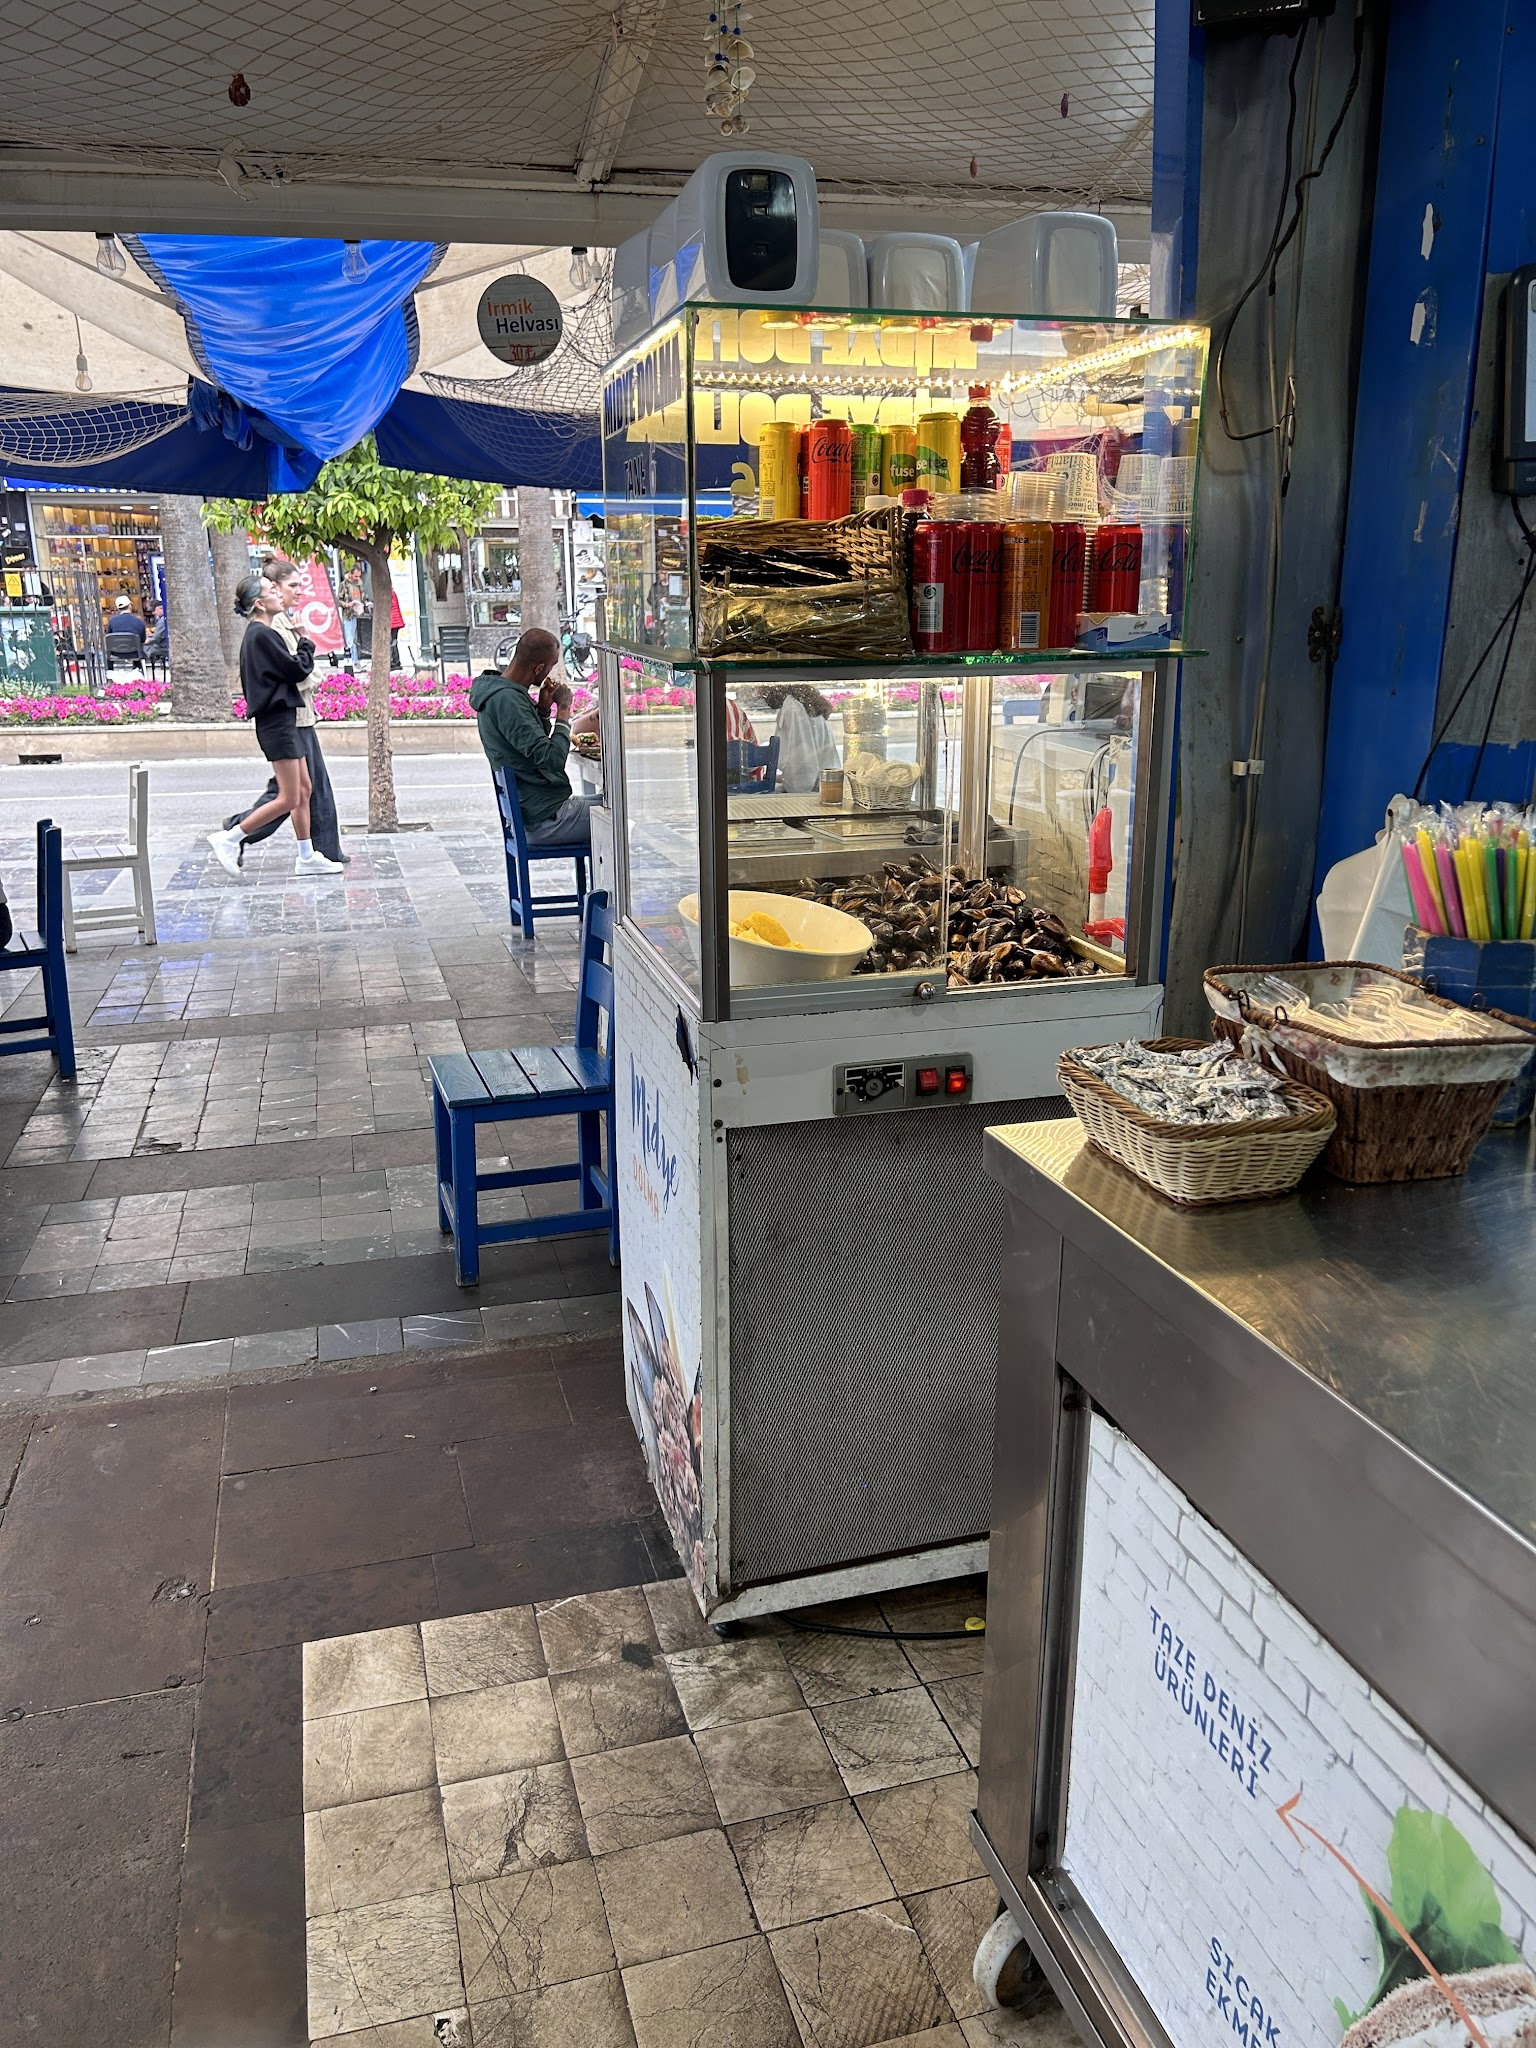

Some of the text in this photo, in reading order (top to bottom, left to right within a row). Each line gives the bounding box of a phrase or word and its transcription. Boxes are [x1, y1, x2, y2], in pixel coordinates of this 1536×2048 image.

[487, 298, 534, 317] İrmik
[496, 316, 559, 334] Helvası
[632, 1153, 660, 1224] DOLMA
[1150, 1605, 1272, 1774] TAZE DENİZ
[1154, 1645, 1259, 1800] ÜRÜNLERİ
[1210, 1936, 1281, 2048] SICAK
